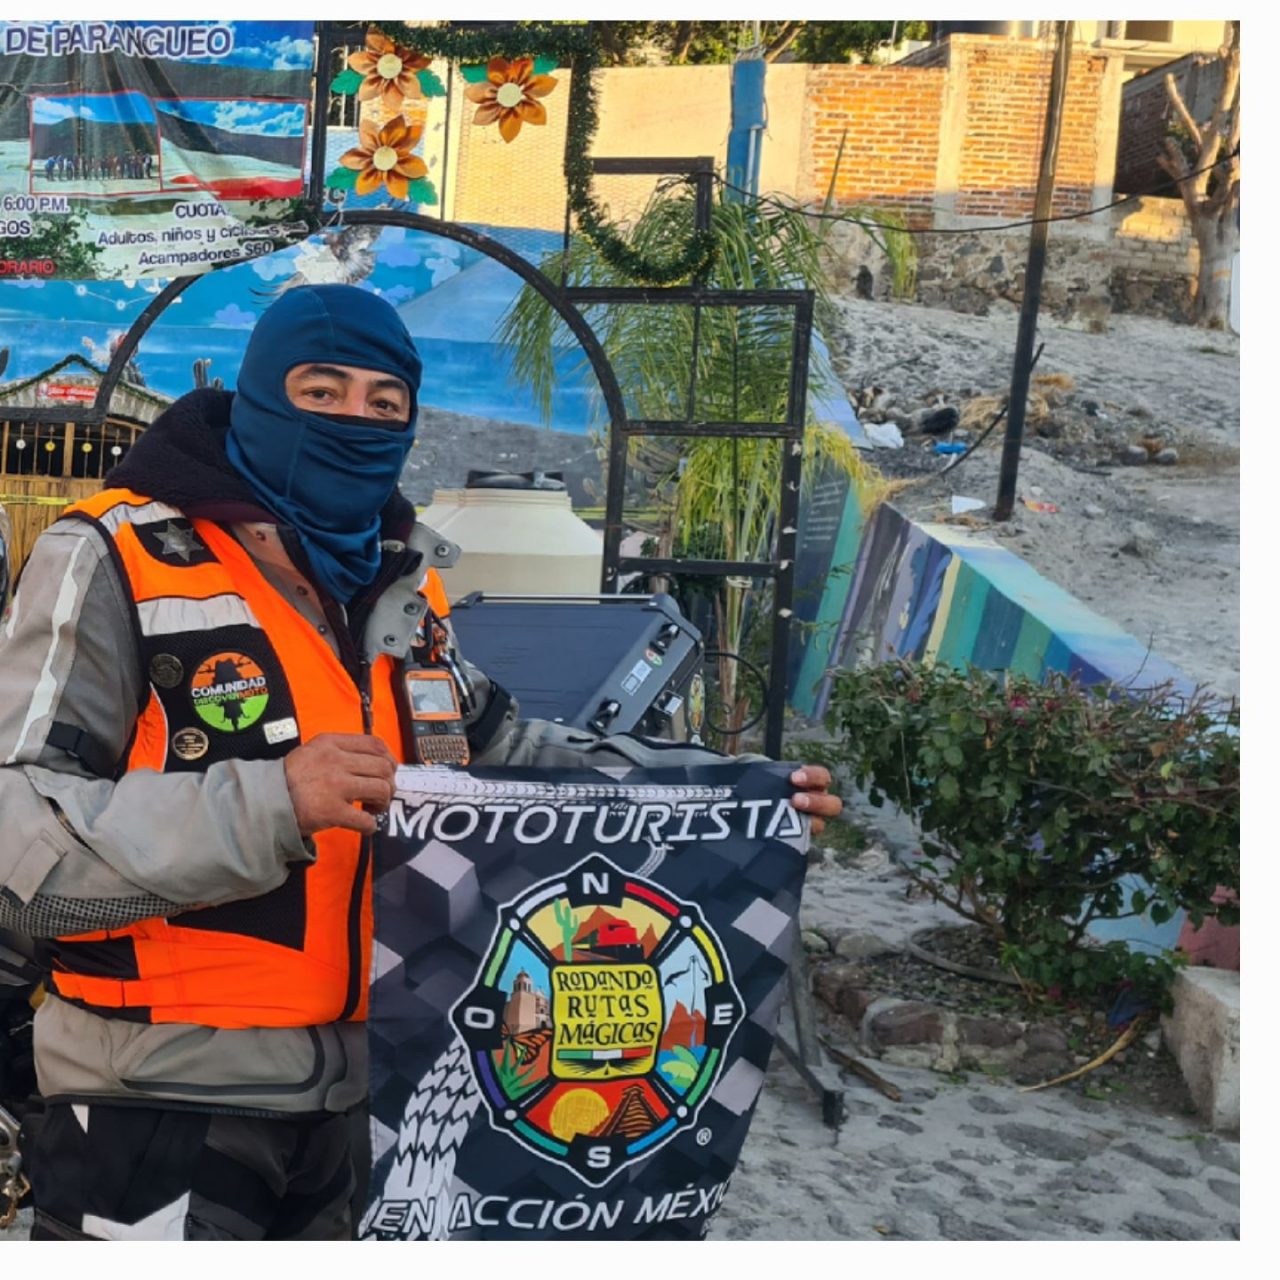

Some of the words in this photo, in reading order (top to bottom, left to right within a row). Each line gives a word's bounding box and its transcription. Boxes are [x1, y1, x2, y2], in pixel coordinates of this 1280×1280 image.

[5, 26, 47, 55] DE
[51, 22, 235, 58] PARANGUEO
[3, 195, 36, 212] 6:00
[161, 226, 202, 242] niños
[206, 228, 216, 243] y
[138, 249, 240, 266] Acampadores
[191, 676, 266, 698] COMUNIDAD
[387, 798, 804, 846] MOTOTURISTA
[582, 872, 609, 895] N
[712, 1004, 733, 1024] E
[587, 1146, 611, 1167] S
[370, 1198, 436, 1233] EN
[448, 1194, 624, 1230] ACCIÓN
